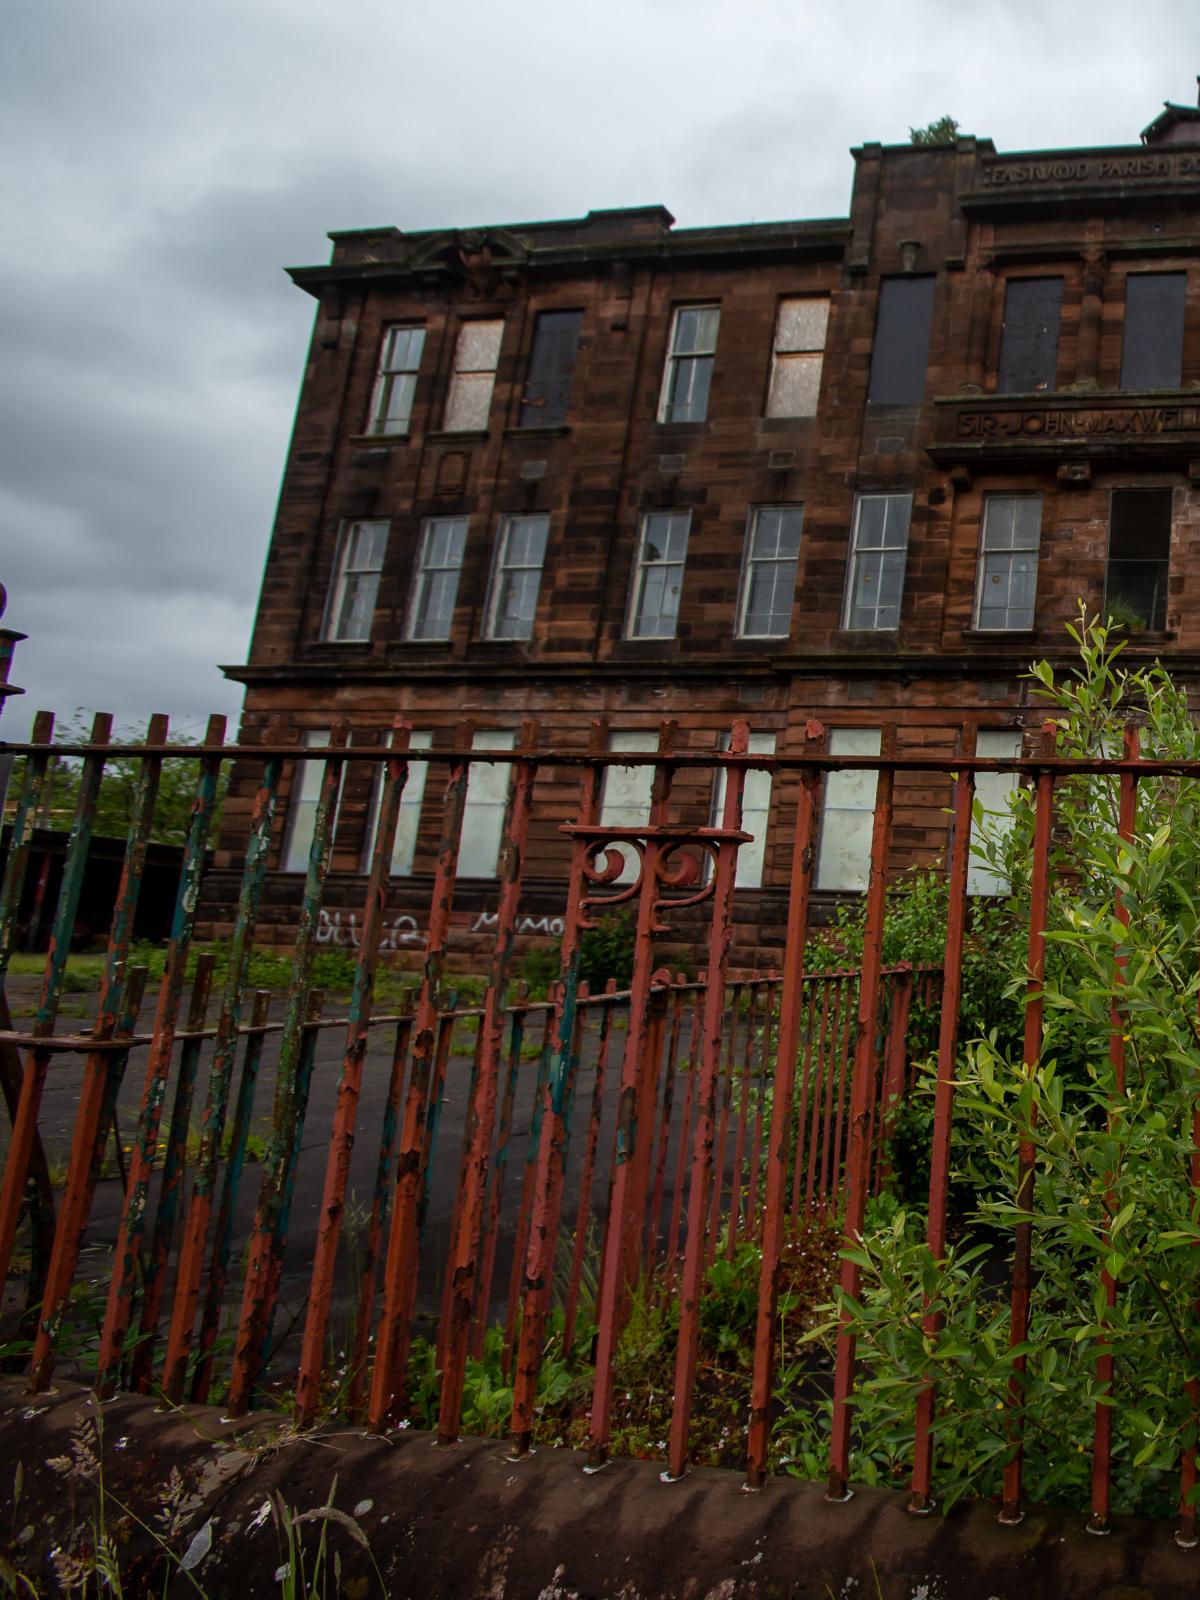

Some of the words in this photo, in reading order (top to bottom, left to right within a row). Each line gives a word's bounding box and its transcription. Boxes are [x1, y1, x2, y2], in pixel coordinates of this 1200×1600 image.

[1098, 159, 1169, 178] PARISH
[957, 414, 996, 437] SIR
[1007, 411, 1075, 435] JOHN
